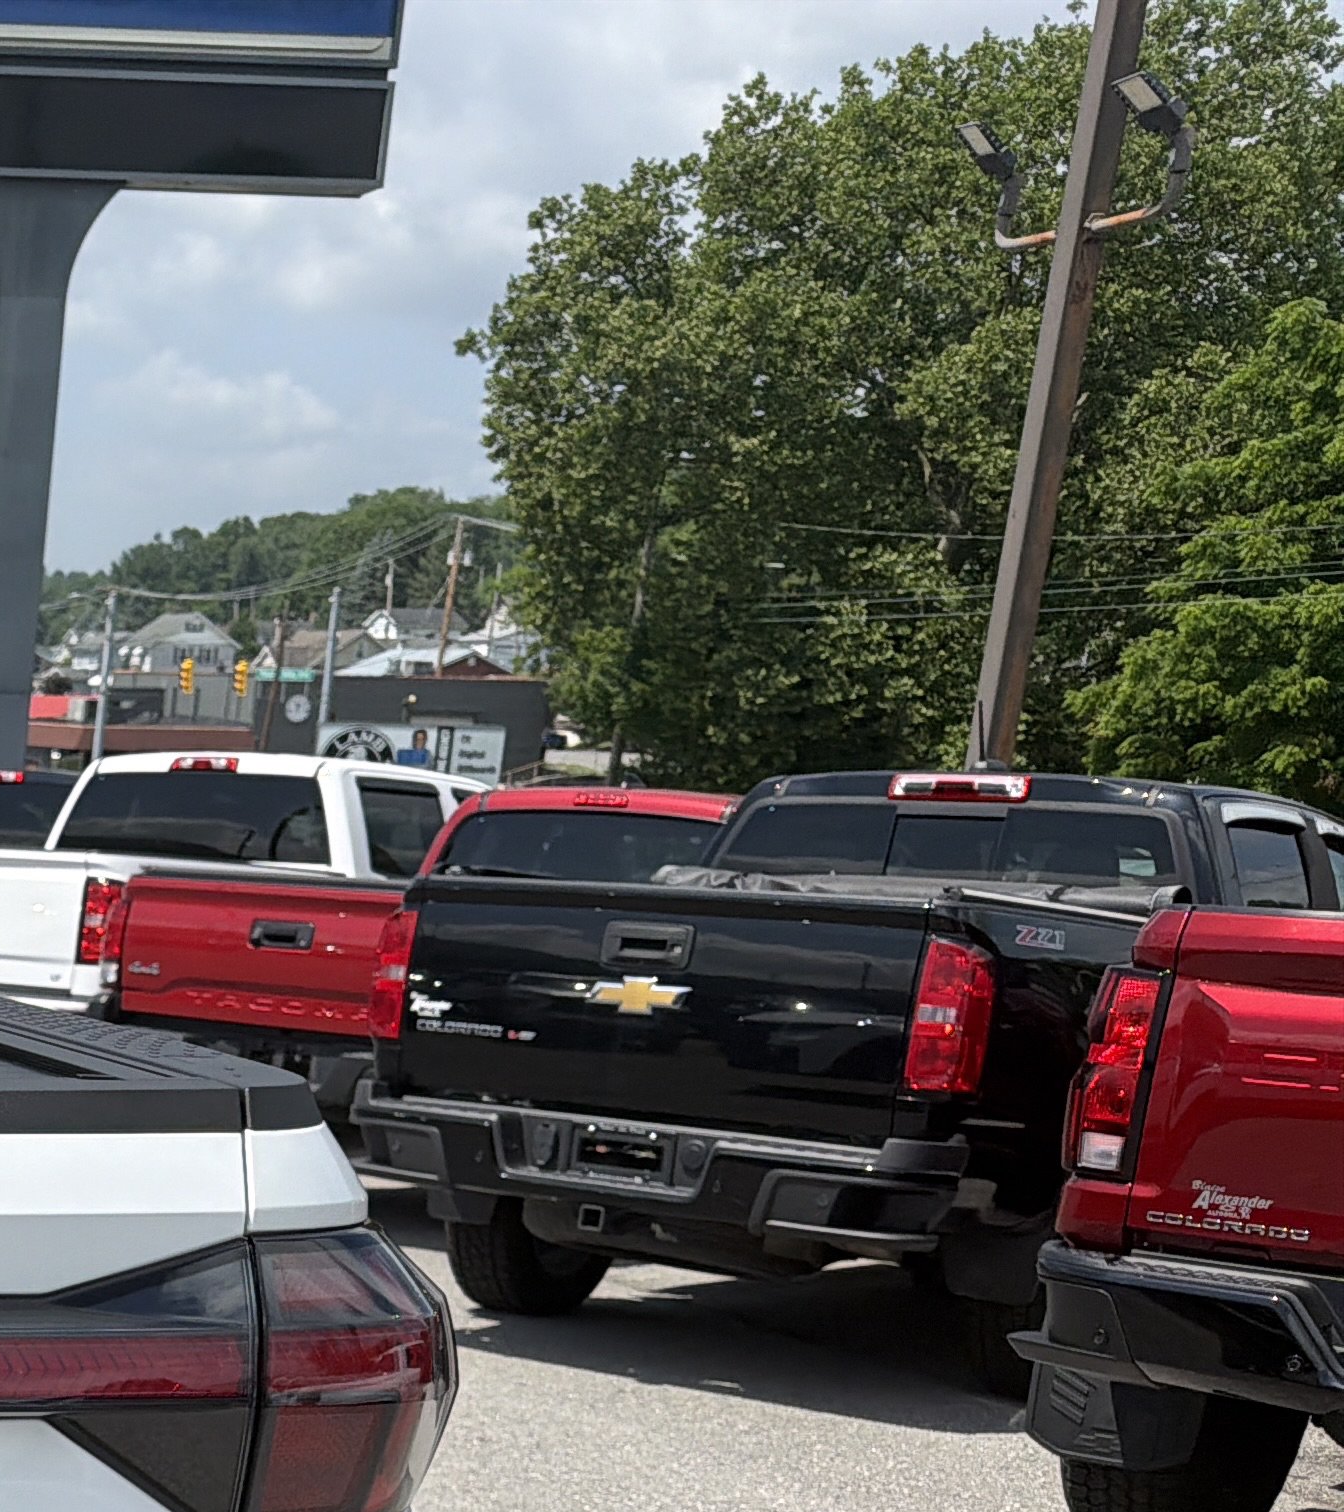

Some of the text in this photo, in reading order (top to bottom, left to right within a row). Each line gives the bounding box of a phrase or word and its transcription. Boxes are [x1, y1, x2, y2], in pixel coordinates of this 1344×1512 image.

[333, 730, 388, 754] LAMB
[416, 1018, 504, 1038] COLORADO
[1191, 1190, 1274, 1210] Alexander
[1146, 1210, 1310, 1242] COLORADO
